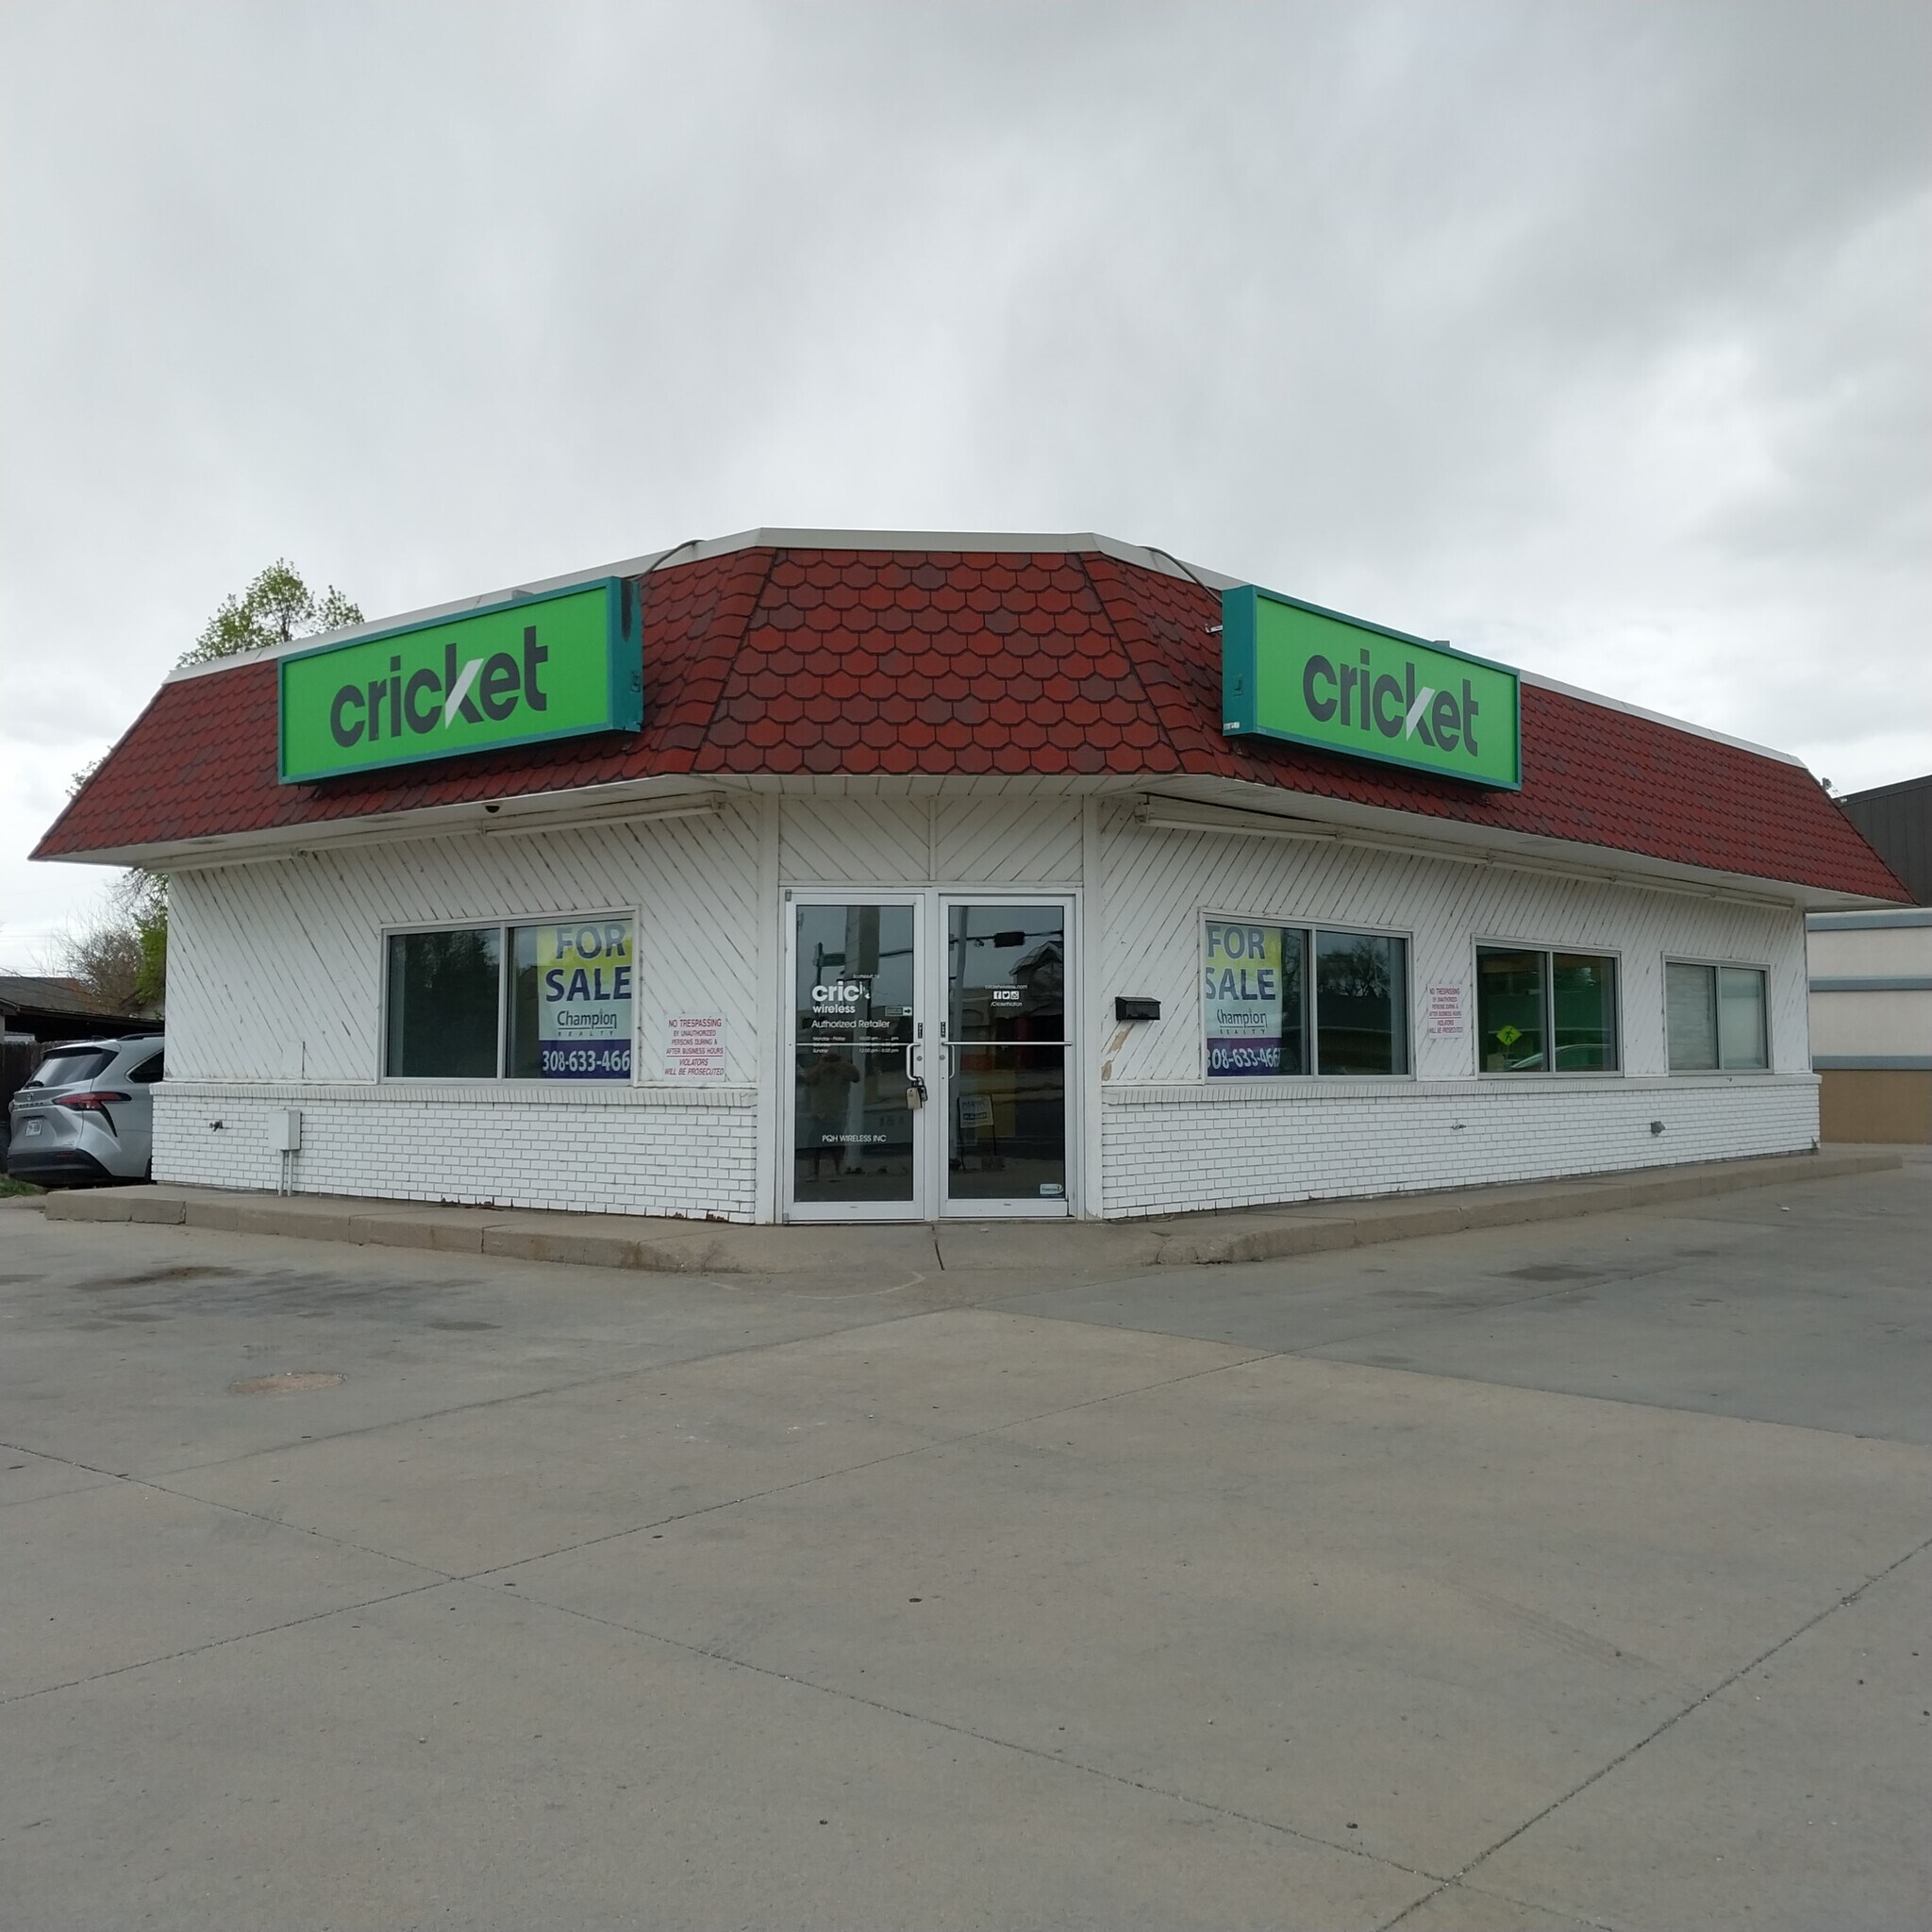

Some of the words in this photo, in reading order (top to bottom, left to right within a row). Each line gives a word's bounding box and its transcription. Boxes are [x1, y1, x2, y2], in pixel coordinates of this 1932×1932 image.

[330, 625, 549, 748] cricket
[1303, 648, 1479, 758] cricket
[556, 924, 626, 959] FOR
[1207, 925, 1266, 959] FOR
[545, 966, 632, 1002] SALE
[1206, 967, 1275, 1000] SALE
[557, 1008, 617, 1029] Champion
[812, 1004, 856, 1014] wireless
[1216, 1008, 1267, 1028] Champion
[668, 1019, 678, 1028] NO
[679, 1018, 723, 1027] TRESPASSING
[811, 1020, 857, 1028] Authorized
[858, 1019, 891, 1028] Retailer
[688, 1067, 724, 1075] PROSECUTED
[839, 1134, 873, 1142] WIRELESS
[873, 1134, 888, 1142] INC
